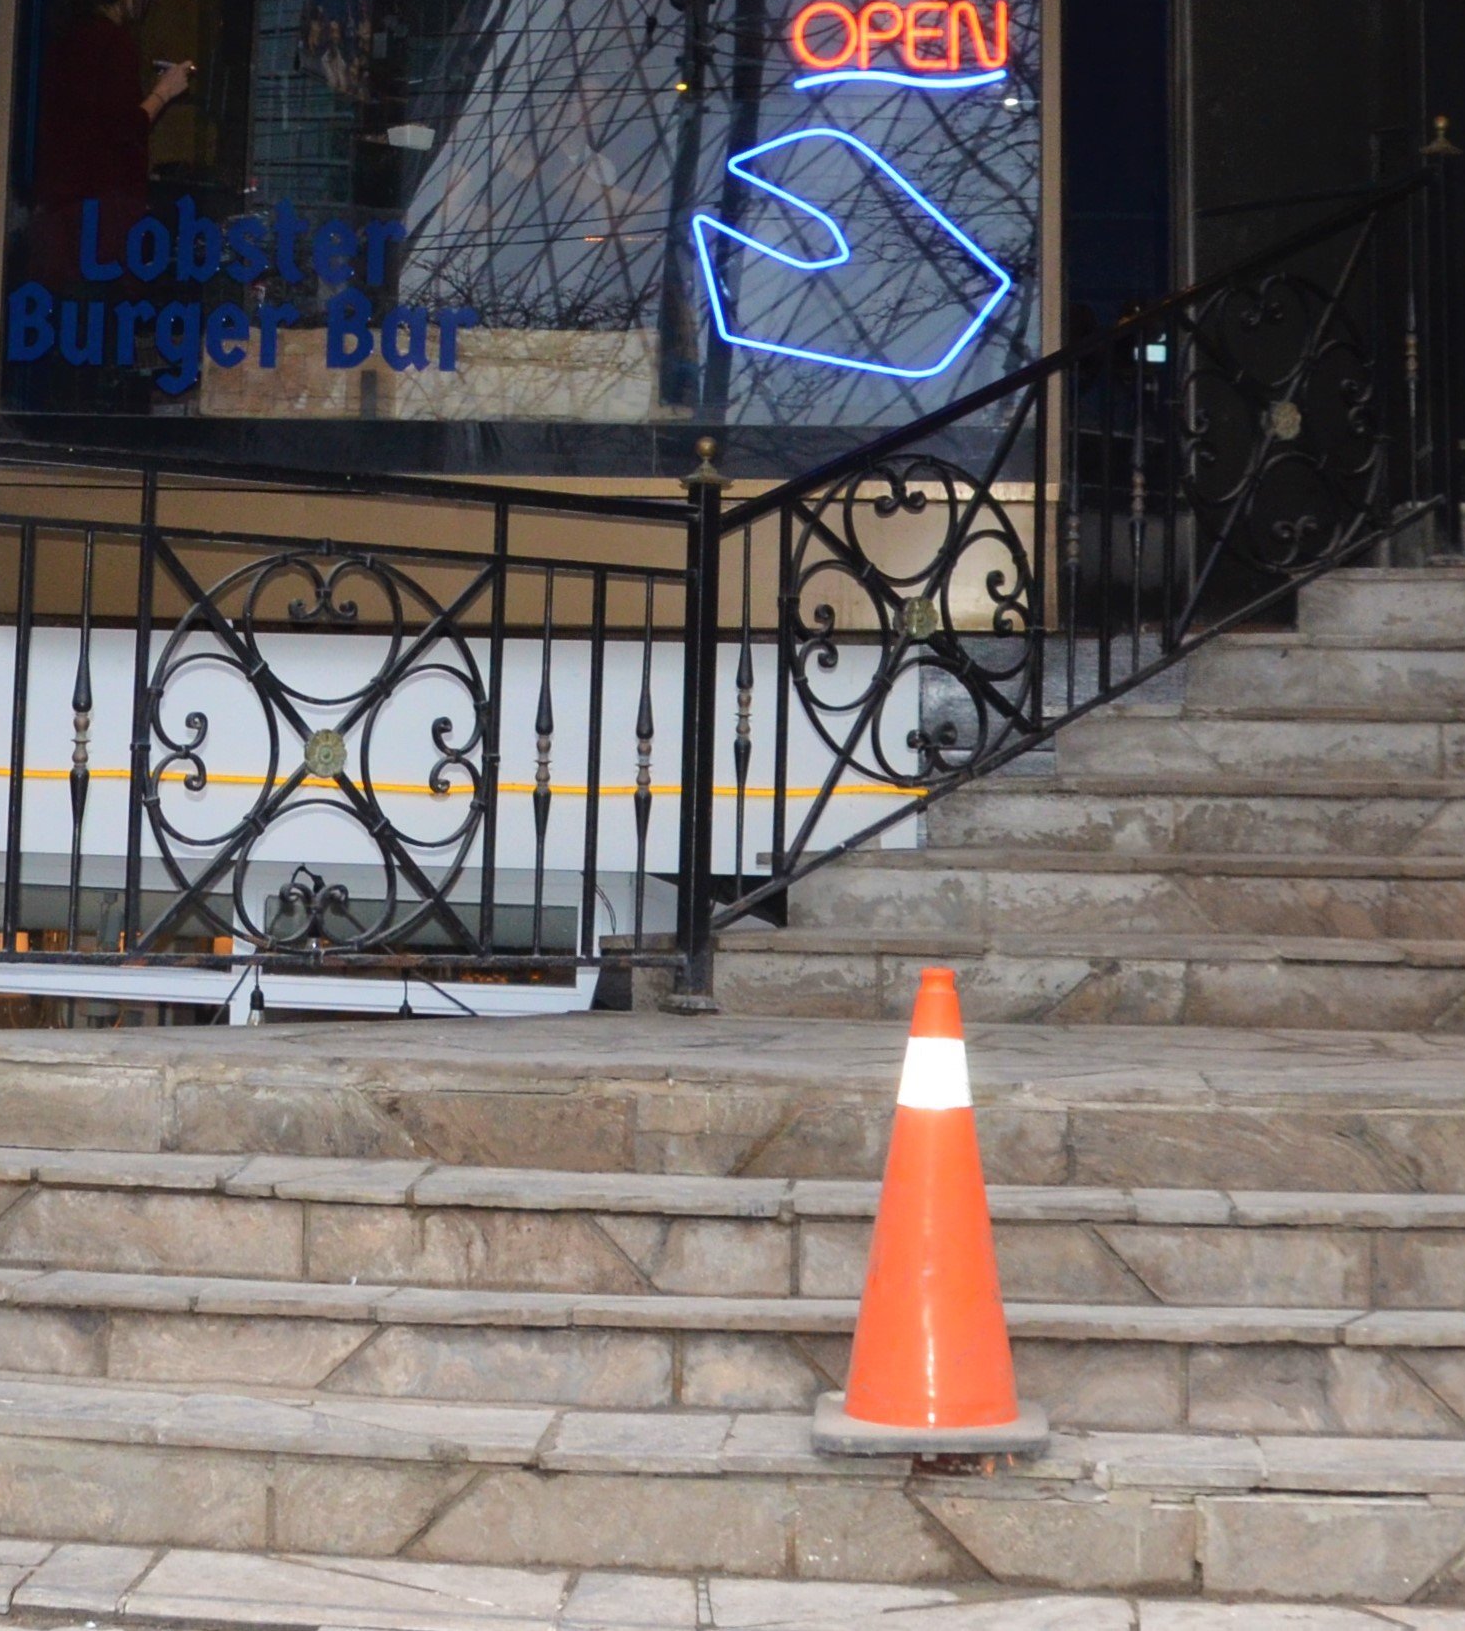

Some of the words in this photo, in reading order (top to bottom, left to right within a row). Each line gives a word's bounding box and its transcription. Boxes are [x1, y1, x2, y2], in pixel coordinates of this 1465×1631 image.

[791, 0, 1009, 71] OPEN
[80, 194, 406, 286] Lobster
[7, 281, 299, 396] Burger
[326, 288, 478, 372] Bar
